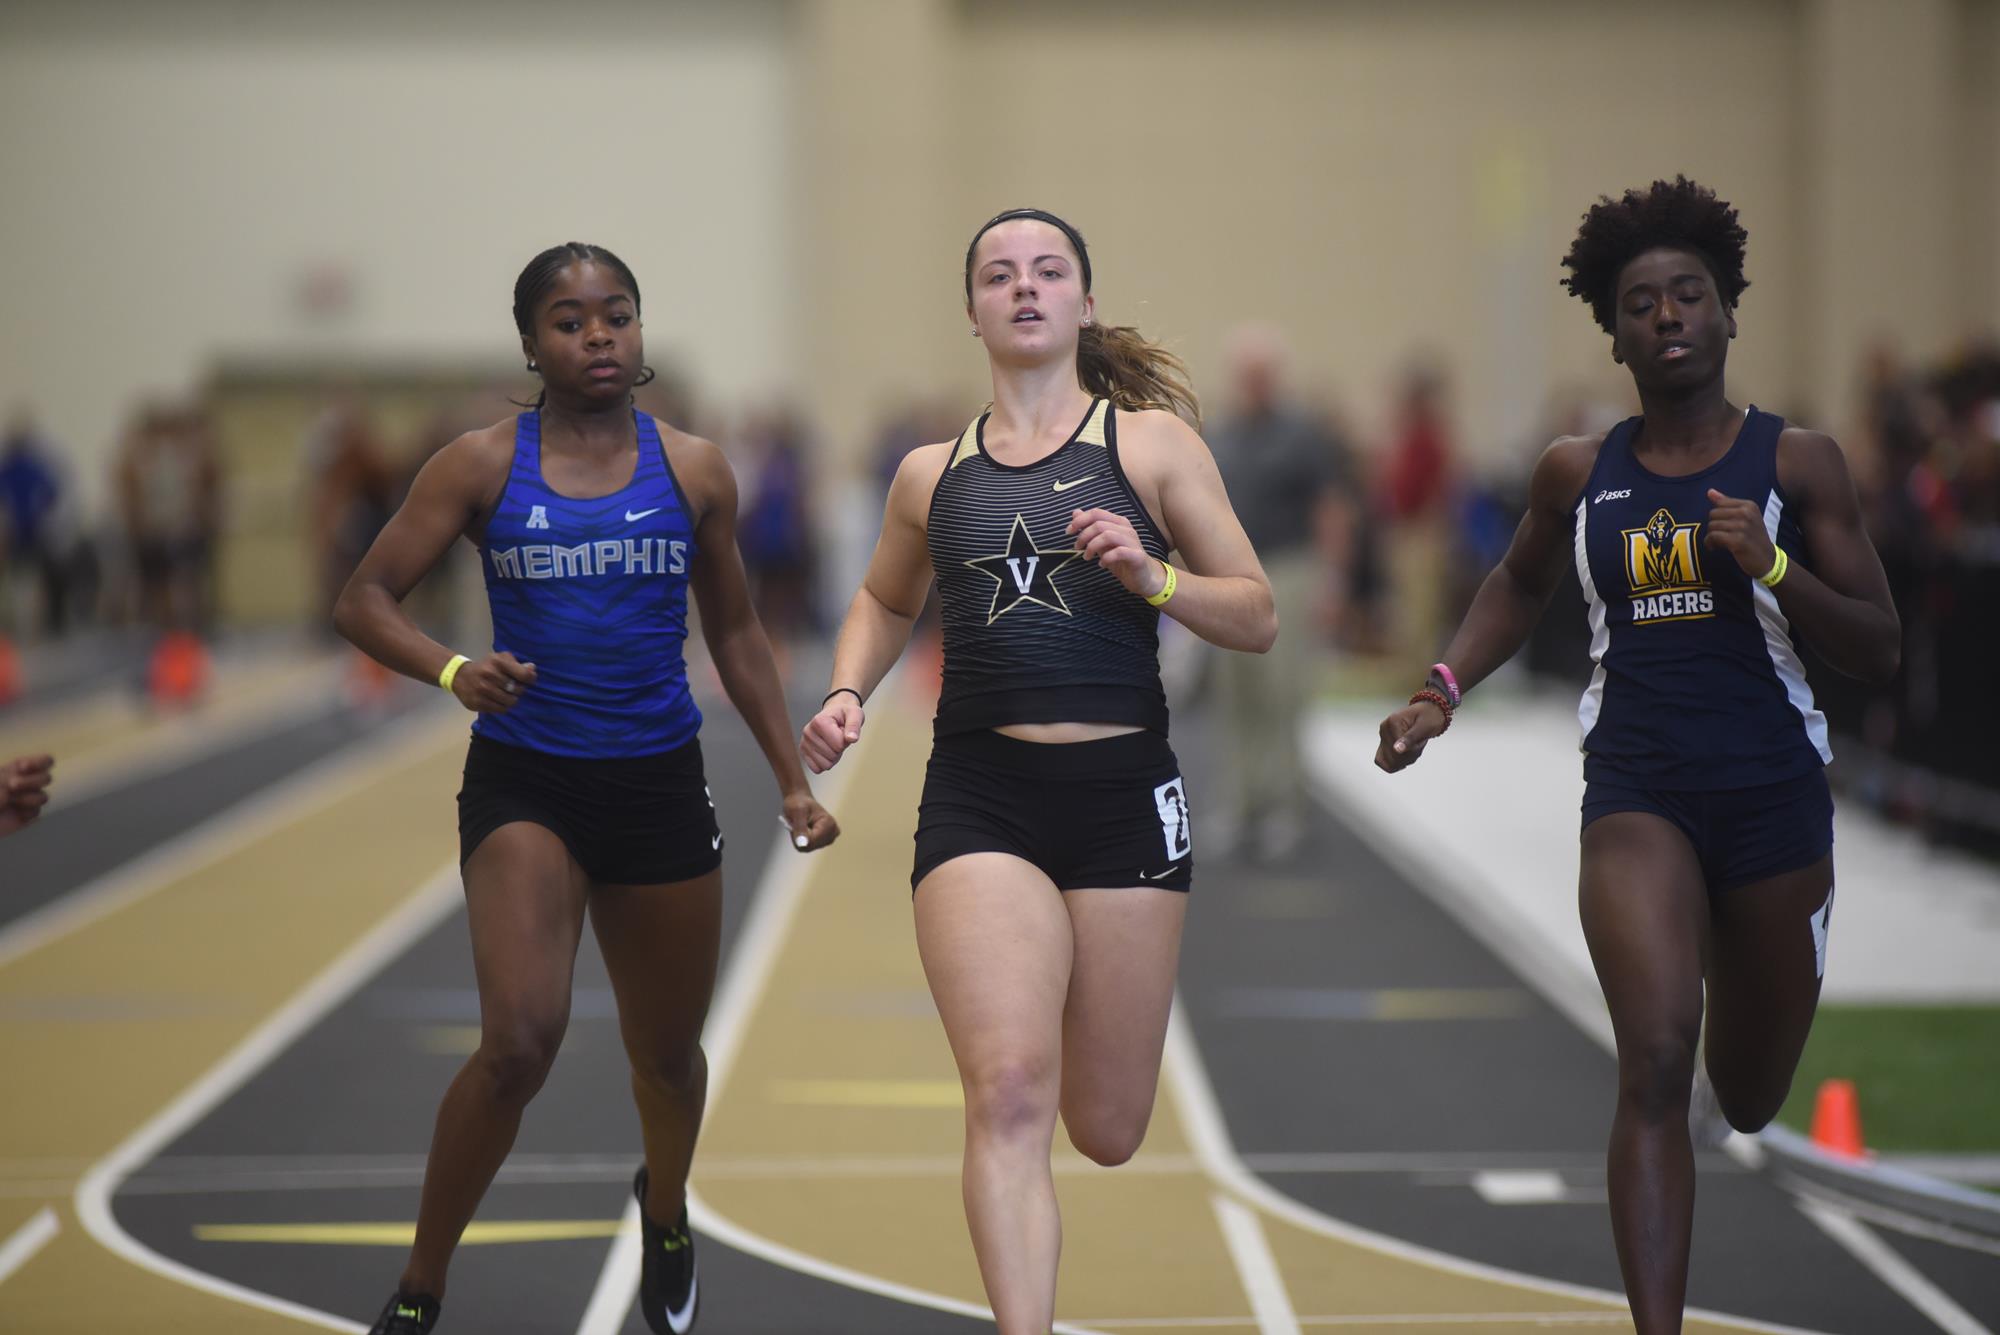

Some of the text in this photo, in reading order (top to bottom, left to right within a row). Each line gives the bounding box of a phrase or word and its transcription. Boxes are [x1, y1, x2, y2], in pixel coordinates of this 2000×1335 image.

[526, 505, 549, 529] A
[490, 538, 687, 579] MEMPHIS
[1006, 556, 1040, 594] V
[1624, 524, 1703, 588] M
[1632, 591, 1714, 621] RACERS
[1164, 786, 1188, 854] 2
